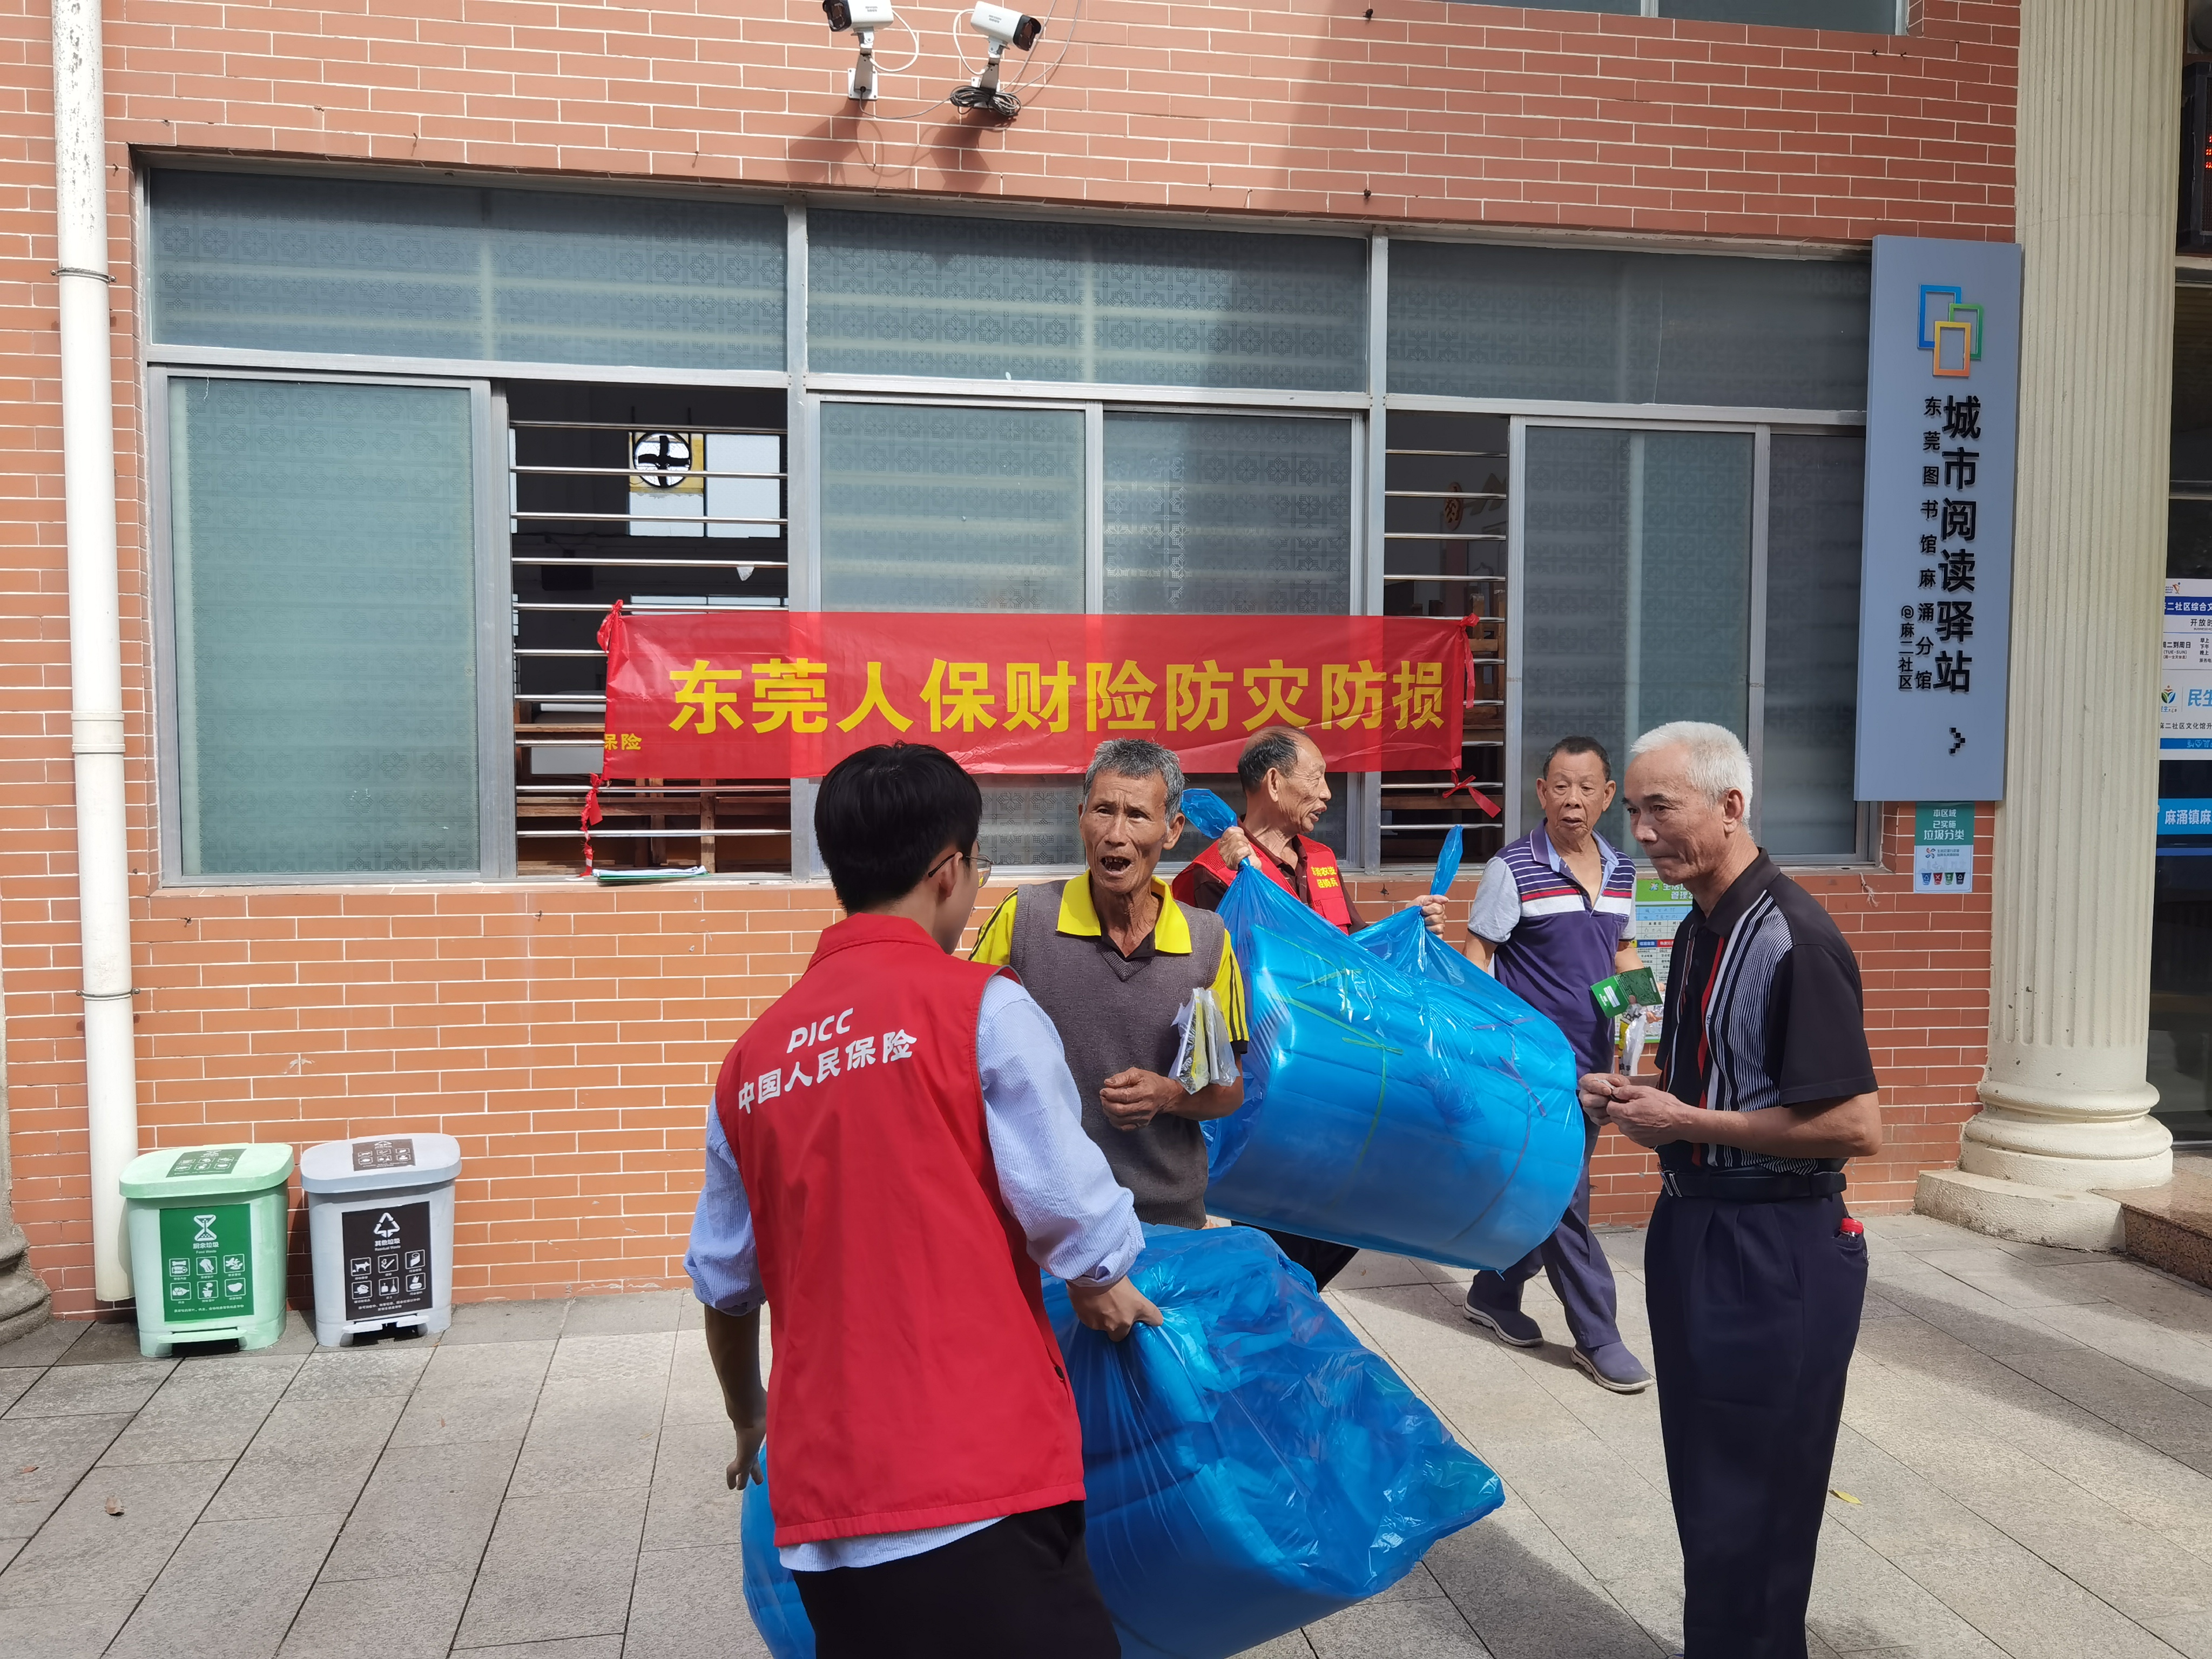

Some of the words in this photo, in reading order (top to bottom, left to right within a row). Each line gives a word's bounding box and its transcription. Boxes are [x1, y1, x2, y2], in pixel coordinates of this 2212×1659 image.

[1914, 396, 1941, 690] 东莞图书馆麻涌分馆
[1933, 395, 1981, 692] 城市阅读驿站
[2164, 602, 2212, 611] 二社区综合文
[1898, 605, 1914, 690] @麻二社区
[669, 658, 1444, 734] 东莞人保财险防灾防损
[2188, 689, 2212, 706] 民生
[1933, 809, 1957, 817] 本区域
[2164, 809, 2212, 825] 麻涌镇麻
[1933, 820, 1956, 828] 已实施
[1924, 830, 1964, 840] 垃圾分类
[786, 1008, 854, 1053] PICC
[738, 1029, 917, 1114] 中国人民保险
[375, 1238, 400, 1246] 其他垃圾
